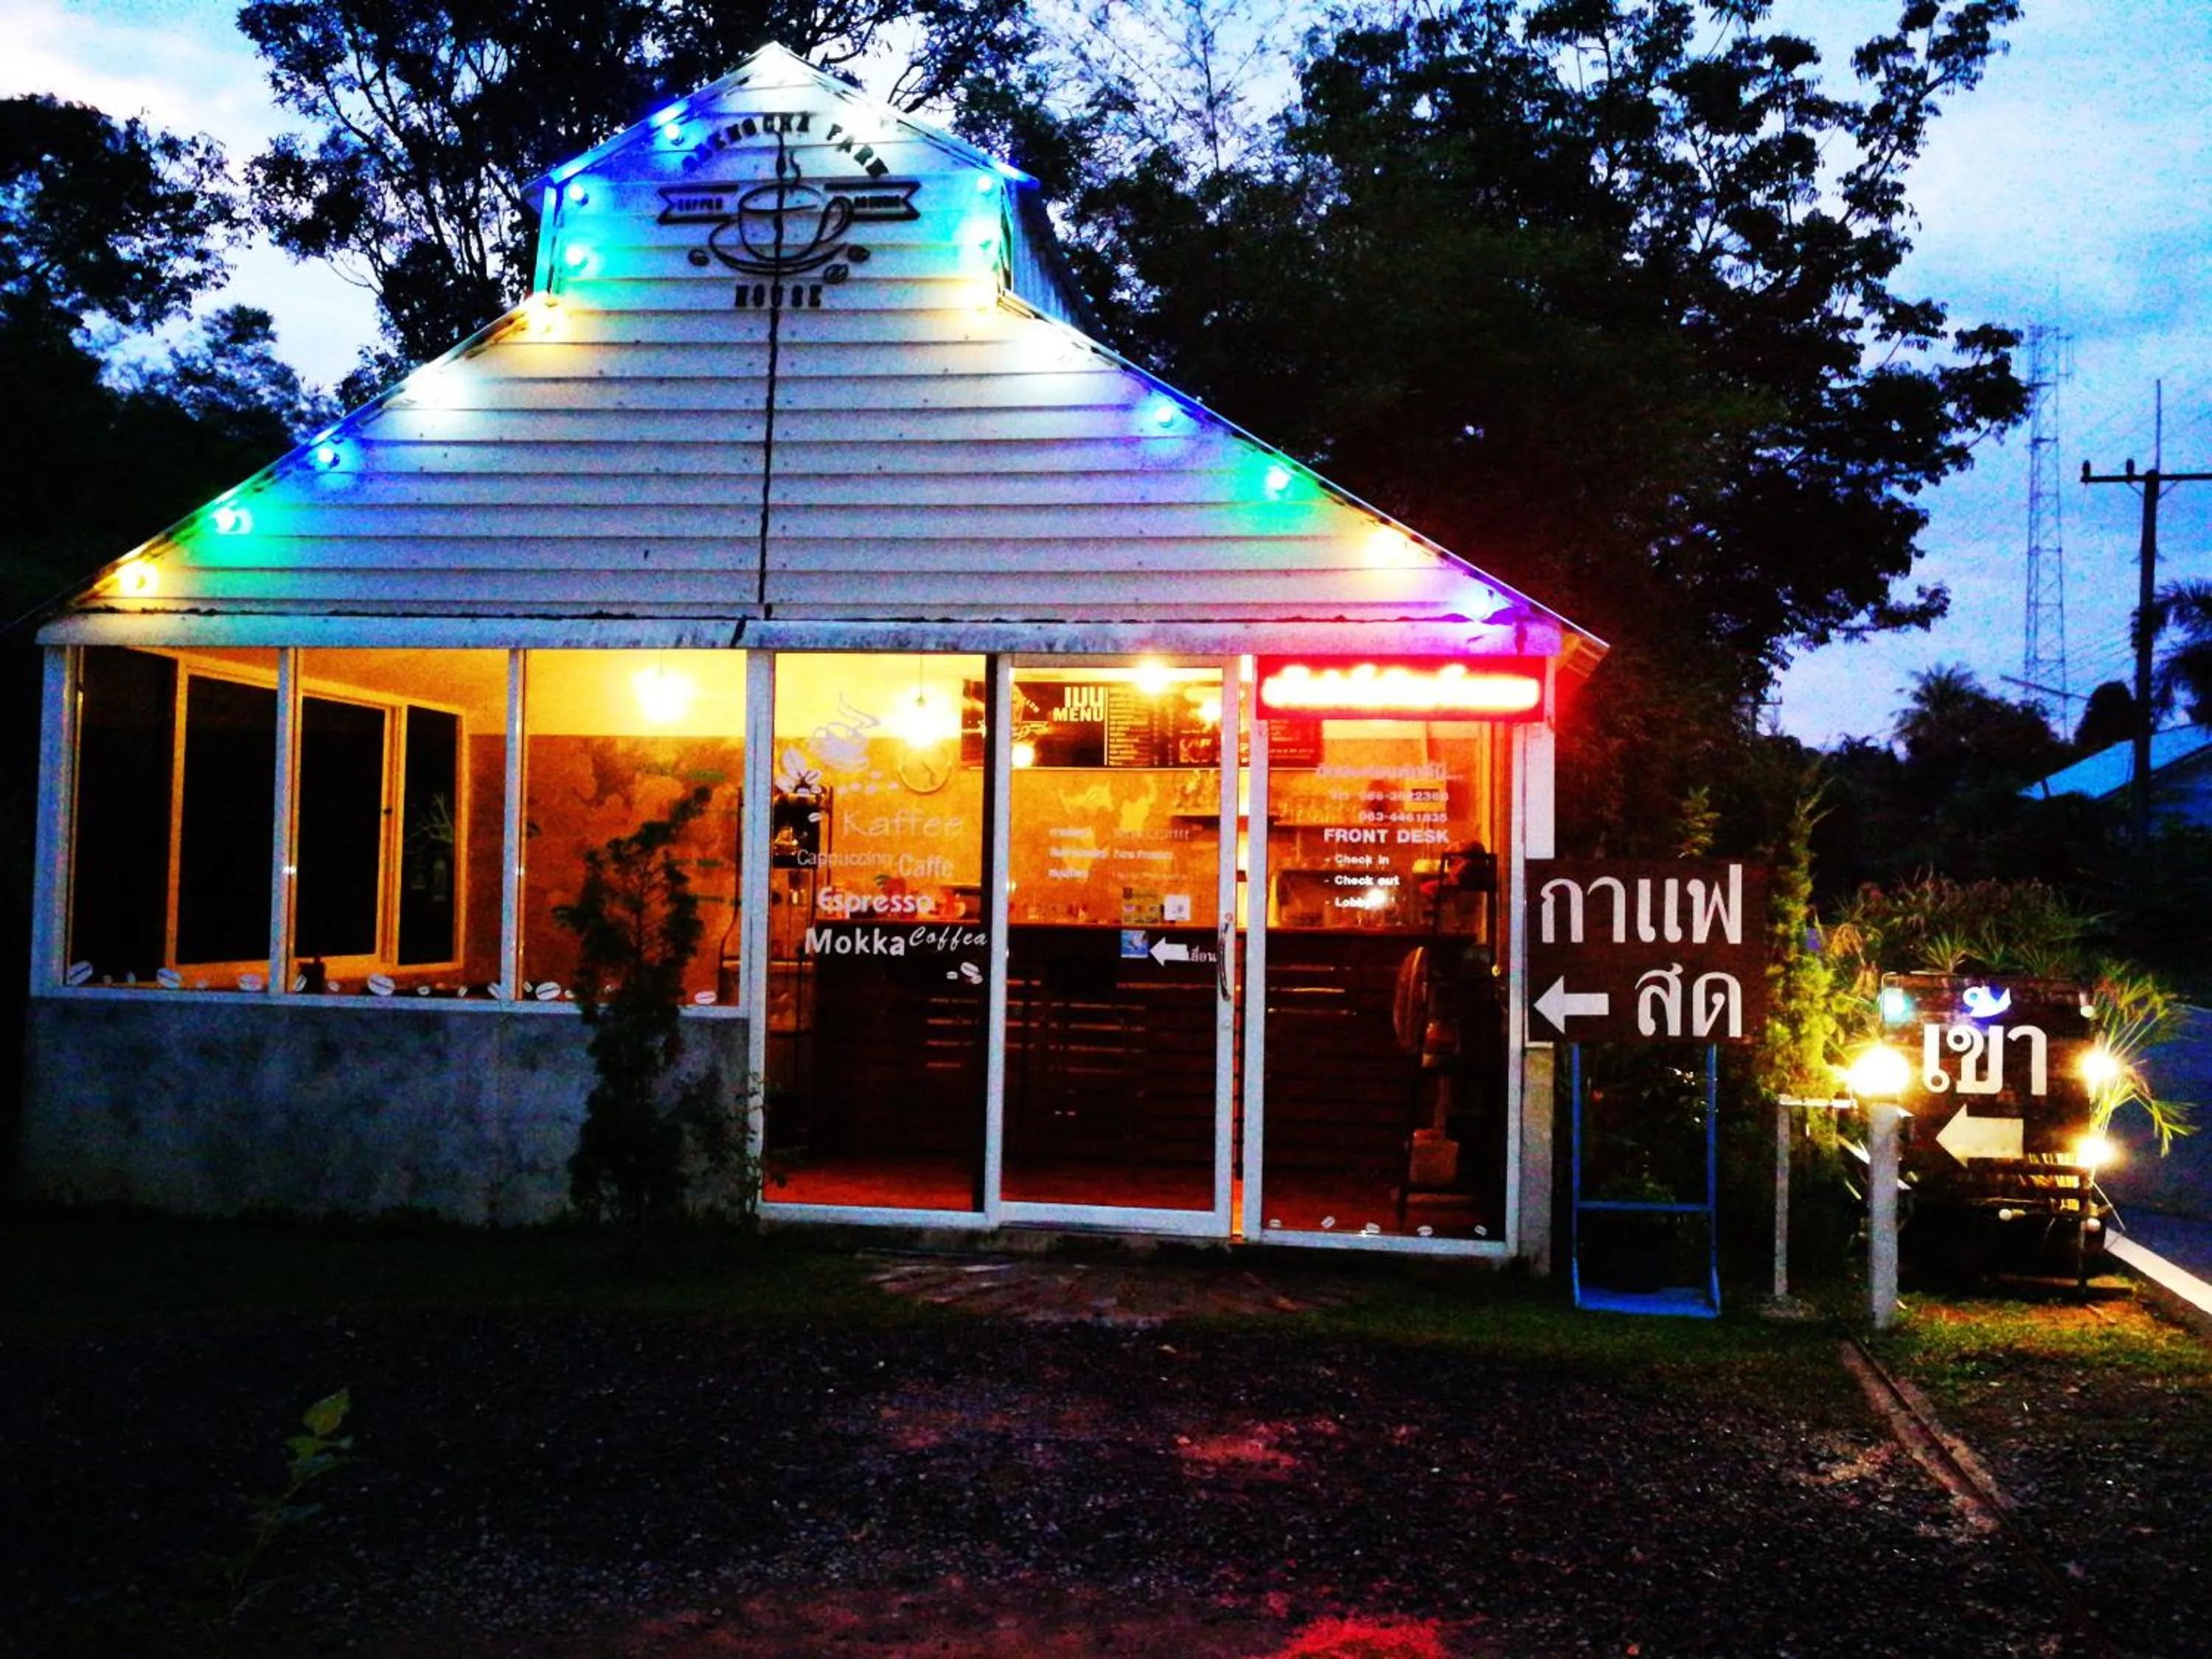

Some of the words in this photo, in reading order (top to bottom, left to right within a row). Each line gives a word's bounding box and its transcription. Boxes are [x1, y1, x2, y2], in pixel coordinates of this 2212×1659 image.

[734, 284, 822, 307] HOUSE
[1052, 707, 1104, 722] MENU
[843, 809, 964, 838] Kaffee
[1324, 828, 1388, 844] FRONT
[1397, 829, 1450, 844] DESK
[1335, 854, 1373, 866] Check
[1334, 875, 1374, 886] Check
[1377, 875, 1400, 886] out
[817, 886, 935, 919] Espresso
[1540, 863, 1742, 945] กาแฟ
[804, 928, 905, 956] Mokka
[1635, 962, 1742, 1038] สด
[1922, 986, 2048, 1096] เข้า
